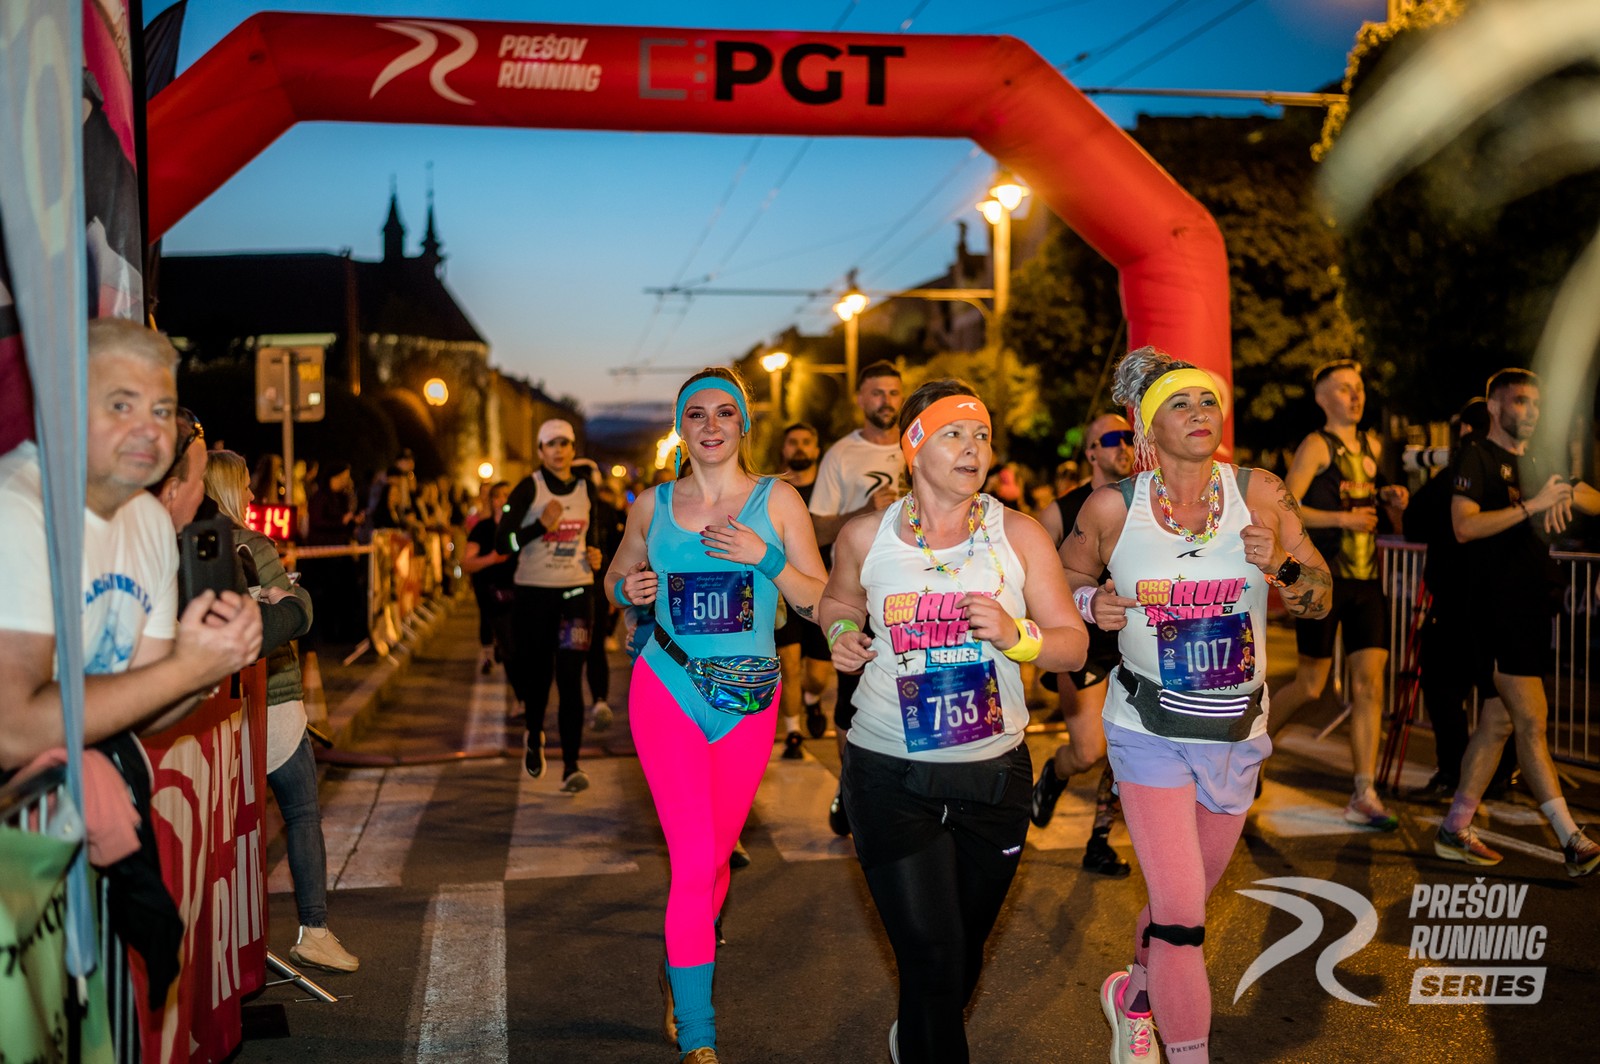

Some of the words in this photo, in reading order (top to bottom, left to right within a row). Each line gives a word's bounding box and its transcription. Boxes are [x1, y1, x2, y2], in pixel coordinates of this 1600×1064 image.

[497, 60, 602, 92] RUNNING
[714, 40, 906, 107] PGT
[245, 507, 290, 538] :14
[693, 591, 729, 620] 501
[1171, 578, 1246, 606] RUN
[930, 647, 979, 664] SERIES
[1184, 637, 1232, 673] 1017
[926, 689, 979, 731] 753
